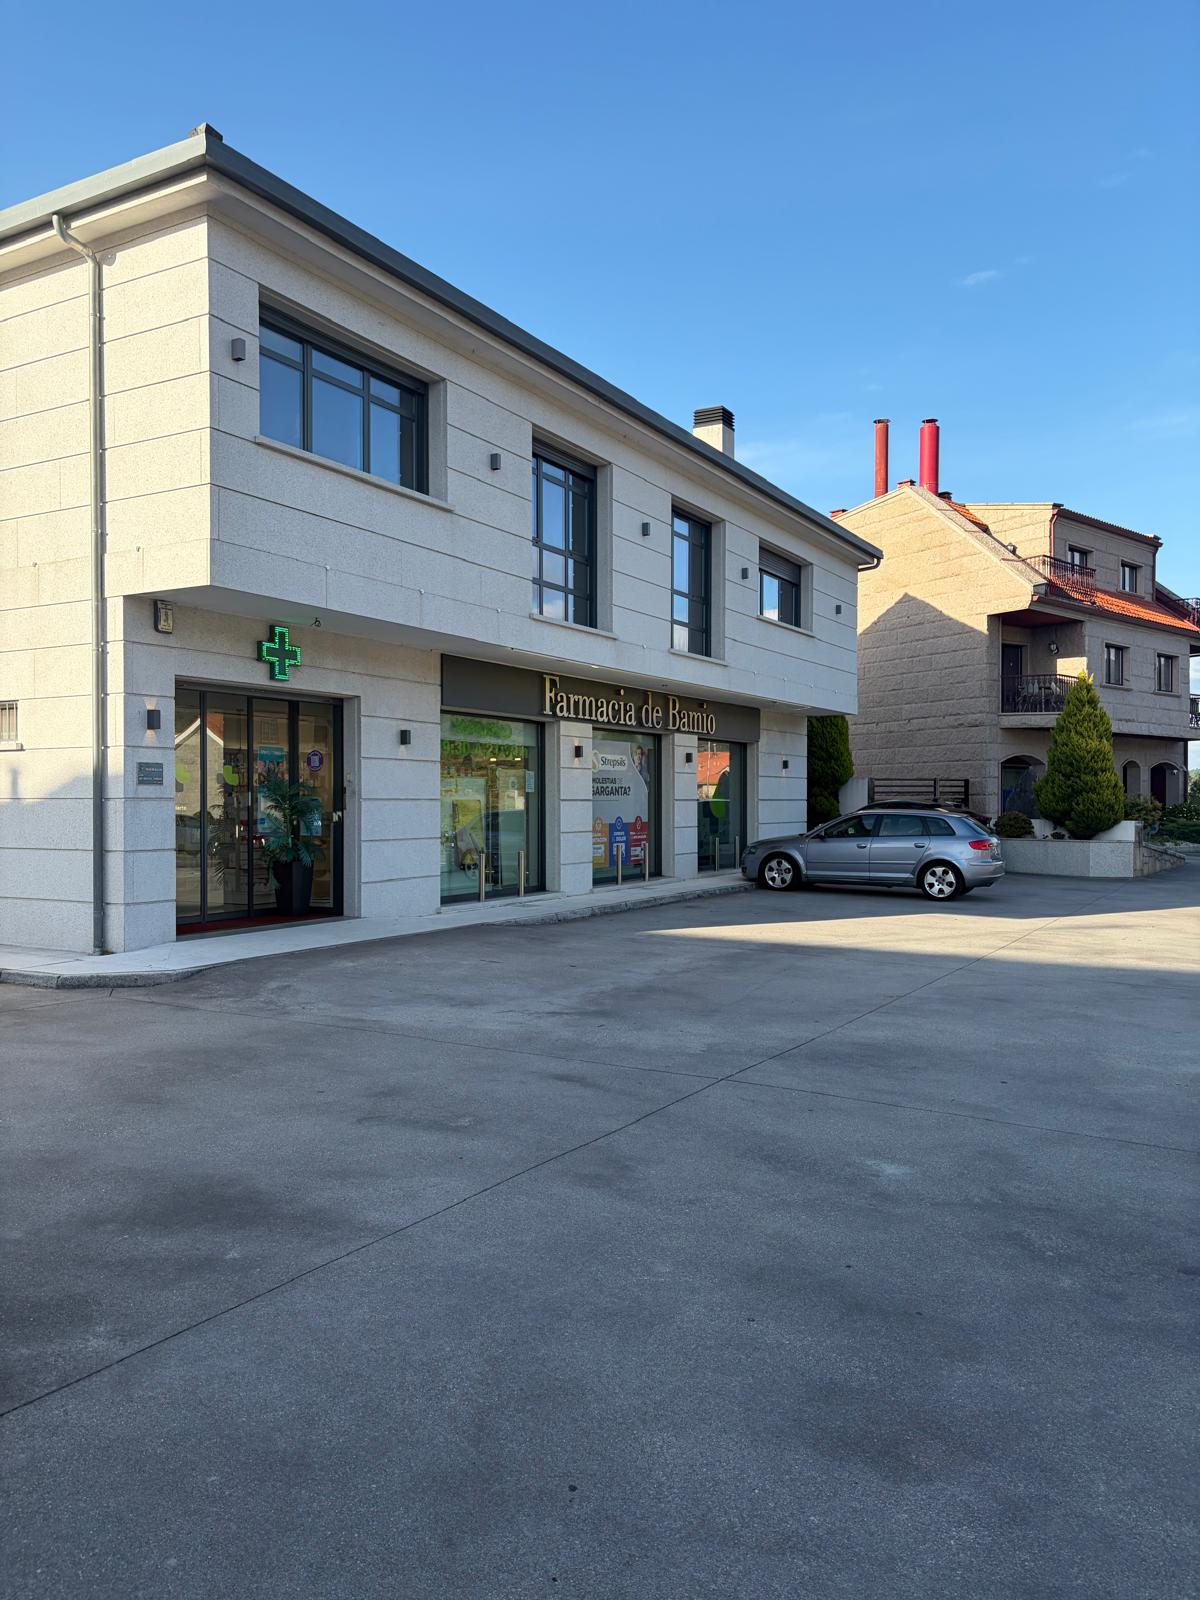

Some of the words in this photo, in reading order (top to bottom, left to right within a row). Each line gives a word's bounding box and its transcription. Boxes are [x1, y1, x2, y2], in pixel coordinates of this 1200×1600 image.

[543, 674, 636, 726] Farmacia
[641, 692, 663, 729] de
[667, 695, 716, 735] Bamio
[601, 756, 626, 768] Strepsils
